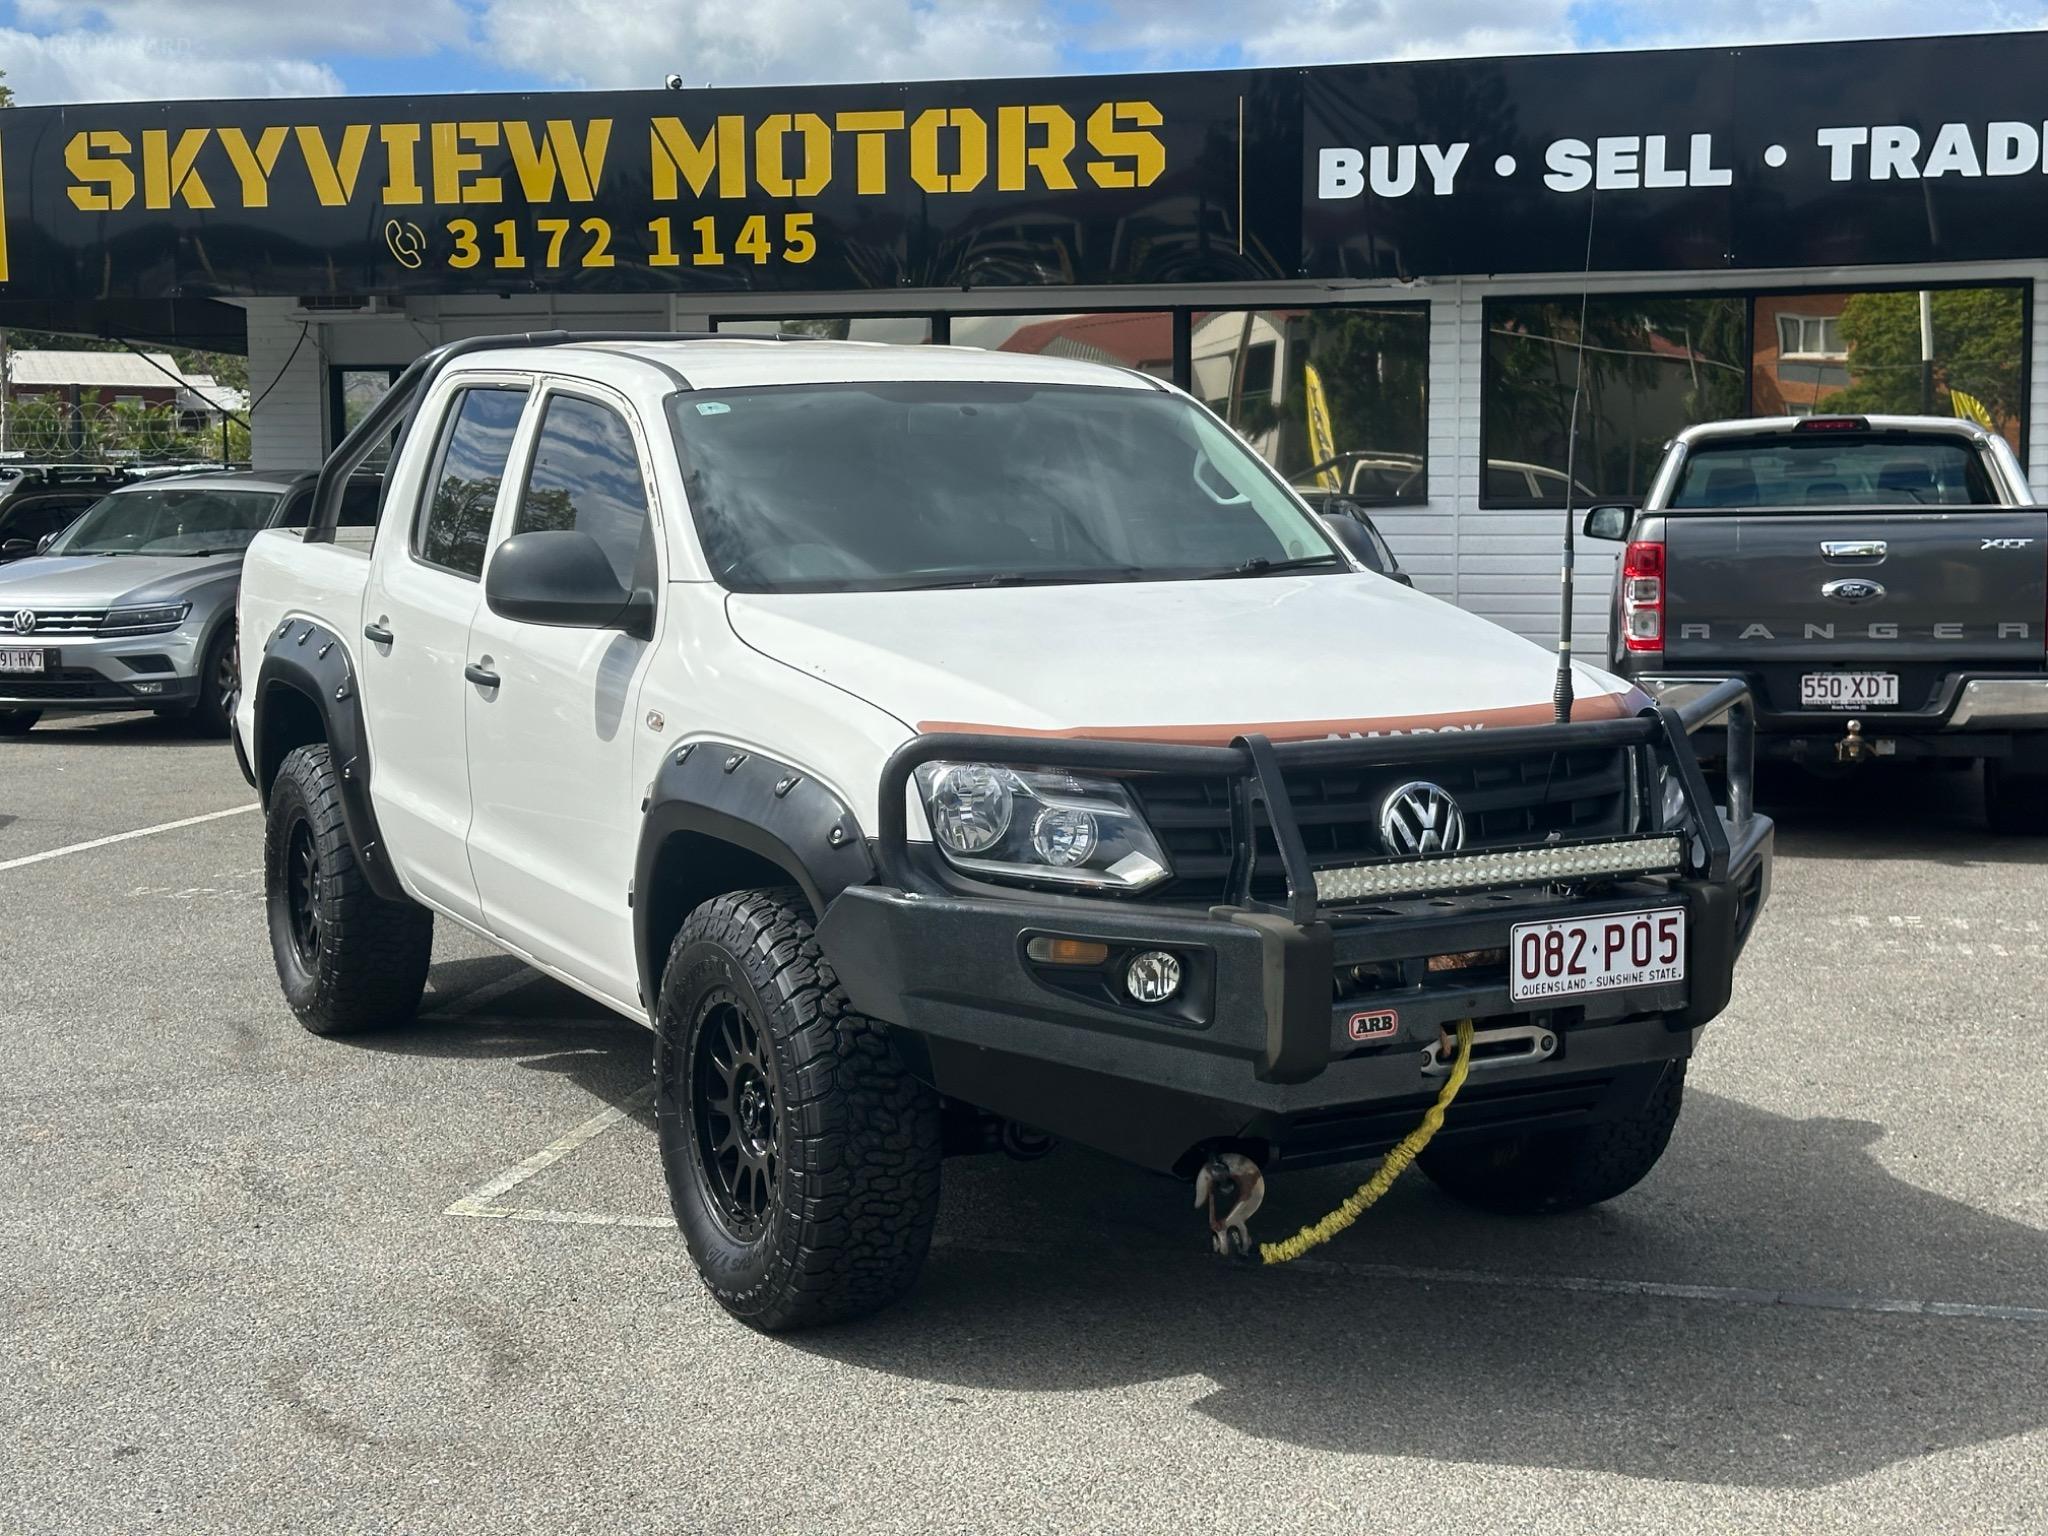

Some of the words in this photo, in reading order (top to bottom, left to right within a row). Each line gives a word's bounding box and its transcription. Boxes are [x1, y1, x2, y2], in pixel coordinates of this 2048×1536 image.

[66, 118, 613, 210] SKYVIEW
[651, 101, 1166, 200] MOTORS
[1318, 142, 1470, 200] BUY
[1543, 133, 1733, 193] SELL
[447, 217, 615, 269] 3172
[648, 212, 817, 267] 1145
[1840, 584, 1867, 597] Ford
[1680, 623, 2029, 639] RANGER
[1522, 978, 1587, 996] QUEENSLAND
[1596, 971, 1644, 987] SUNSHINE
[1649, 967, 1677, 980] STATE
[1355, 1015, 1393, 1034] ARB
